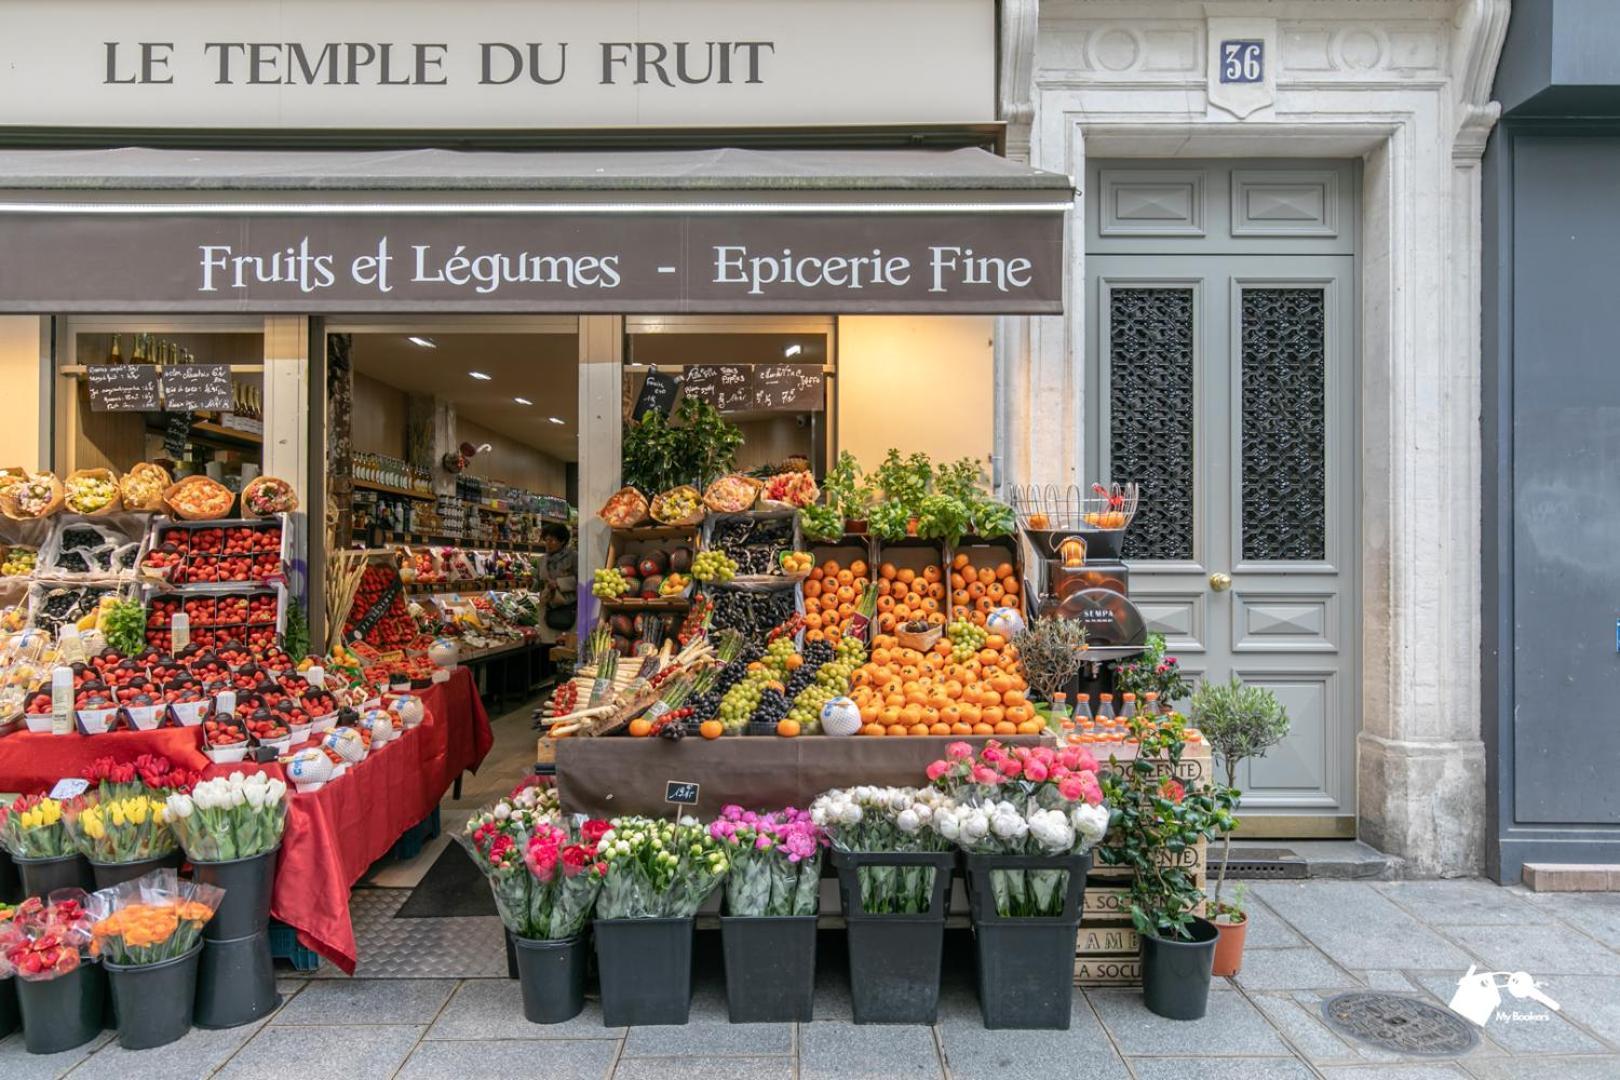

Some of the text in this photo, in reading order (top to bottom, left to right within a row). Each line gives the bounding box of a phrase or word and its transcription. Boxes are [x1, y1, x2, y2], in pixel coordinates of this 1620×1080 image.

[104, 42, 774, 87] LE TEMPLE DU FRUIT
[1225, 44, 1261, 80] 36
[198, 237, 336, 293] Fruits
[352, 237, 394, 293] et
[410, 246, 621, 294] Légumes
[713, 246, 911, 295] Epicerie
[929, 247, 1032, 292] Fine
